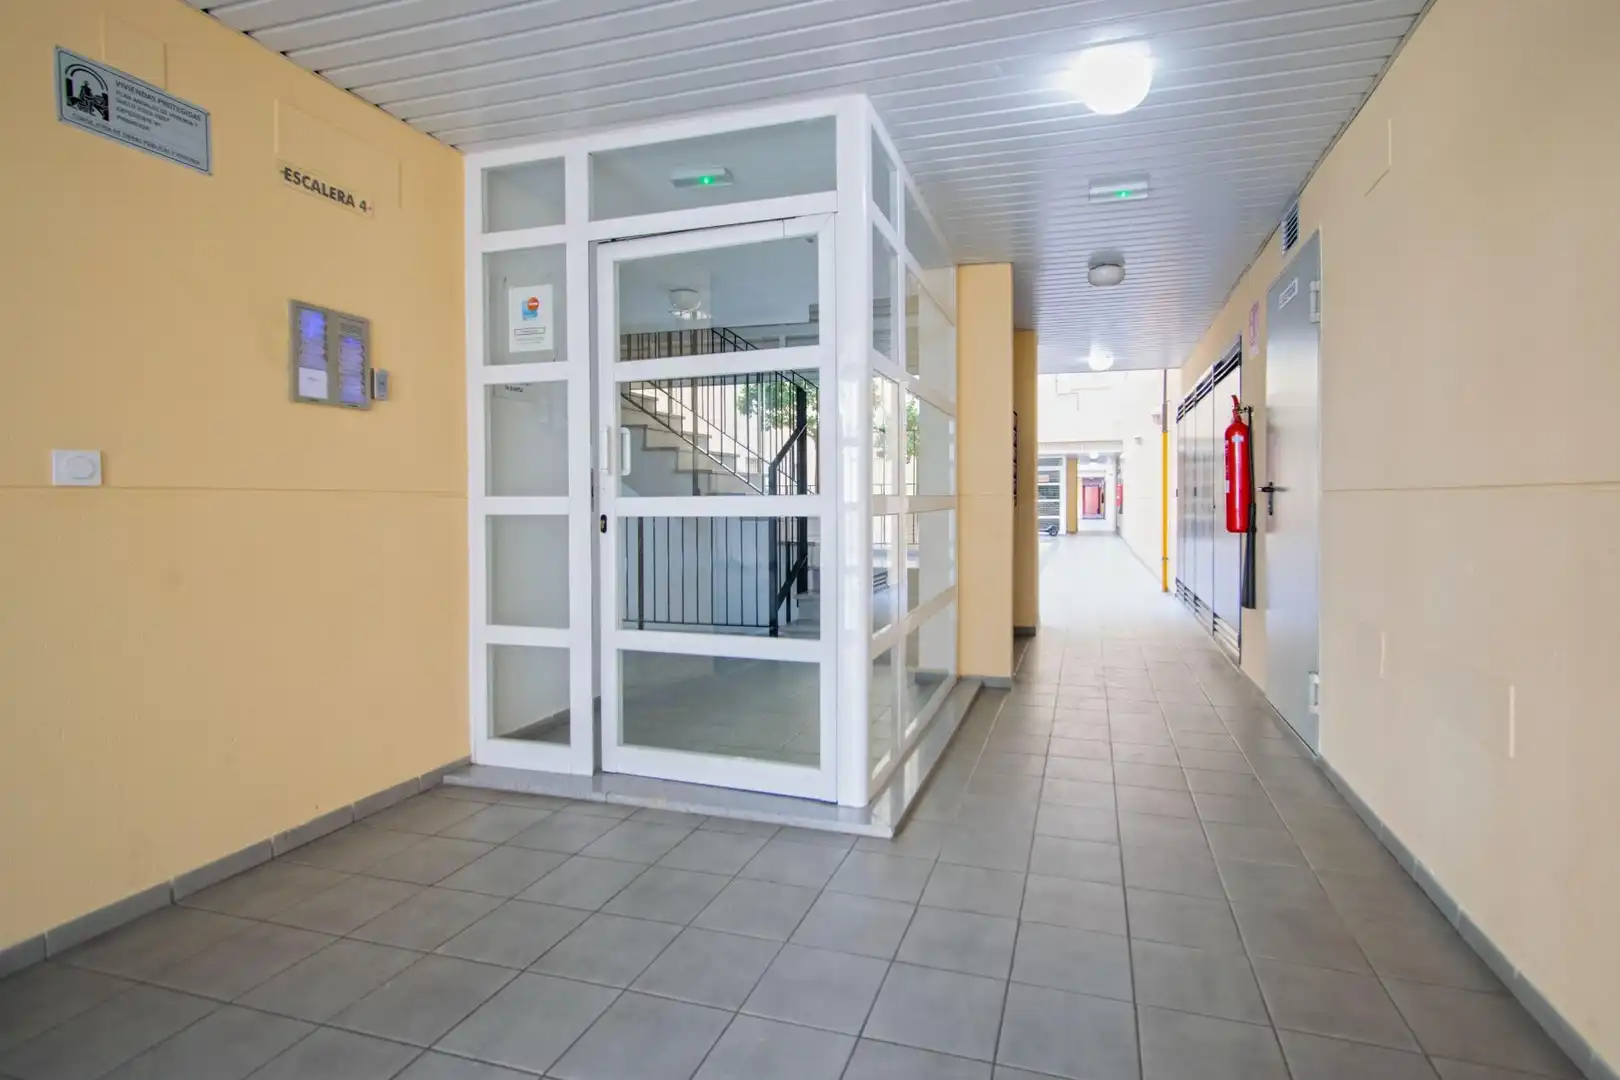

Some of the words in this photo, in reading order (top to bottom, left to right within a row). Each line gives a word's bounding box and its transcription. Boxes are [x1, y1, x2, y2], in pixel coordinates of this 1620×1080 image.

[115, 80, 156, 102] VIVIENDAS
[157, 98, 201, 121] PROTEGIDAS
[284, 166, 356, 208] ESCALERA
[359, 200, 367, 213] 4
